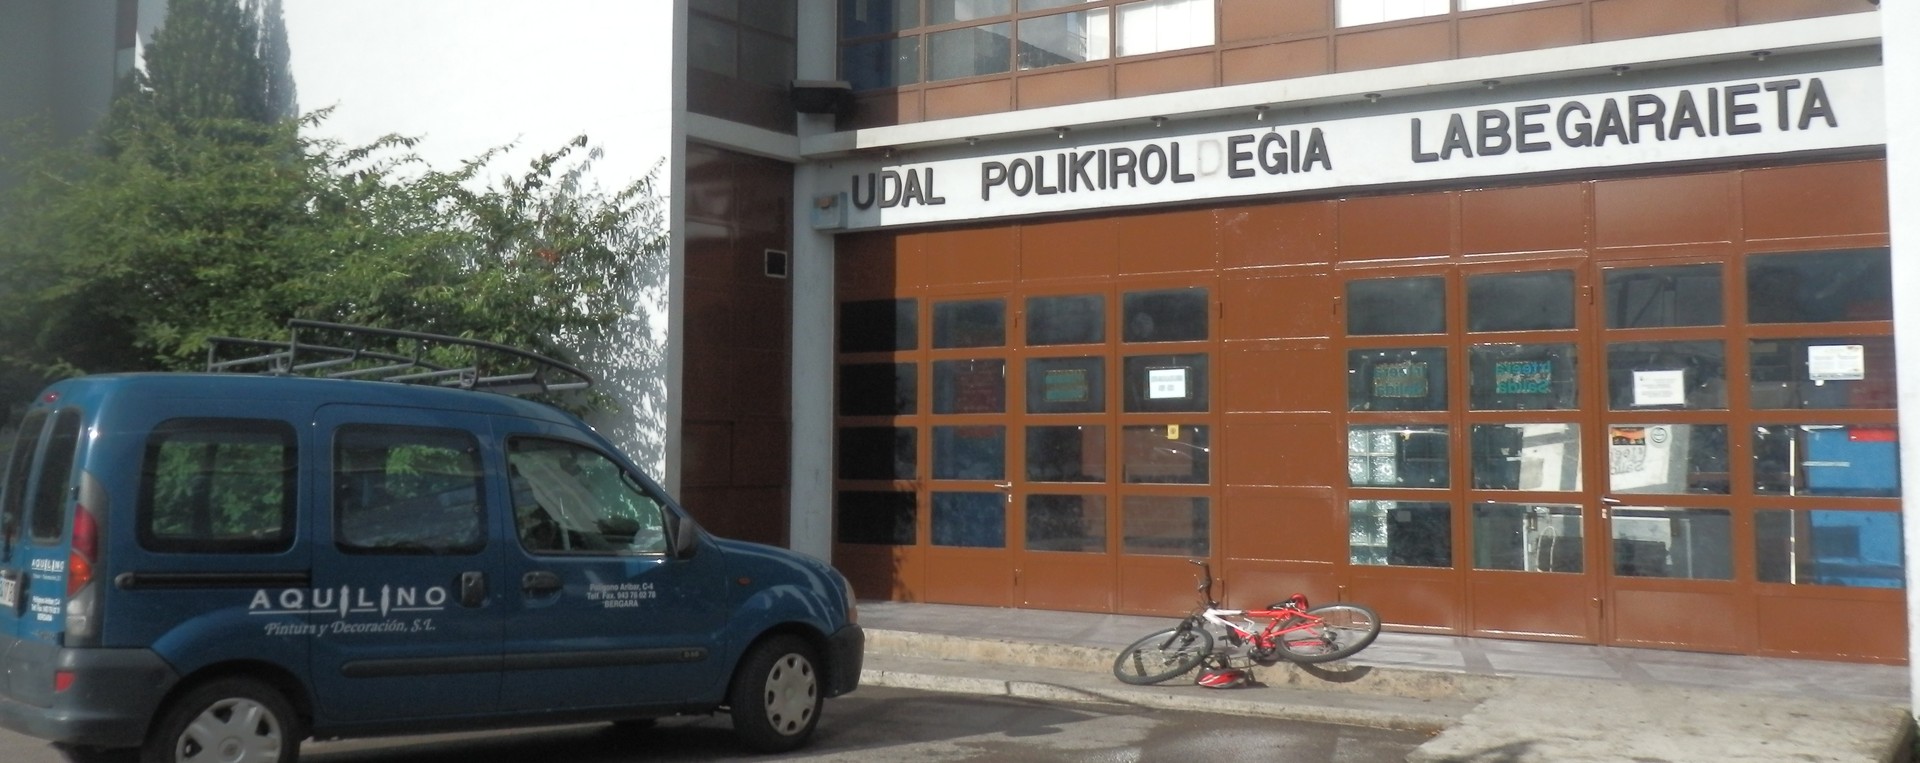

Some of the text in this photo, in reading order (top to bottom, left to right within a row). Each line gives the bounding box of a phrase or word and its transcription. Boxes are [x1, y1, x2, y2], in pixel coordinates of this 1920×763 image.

[852, 167, 946, 210] UDAL
[1410, 77, 1838, 163] LABEGARAIETA
[249, 584, 446, 618] AQUILINO
[604, 600, 638, 608] BERGARA
[264, 621, 316, 636] Pintura
[317, 624, 329, 637] y
